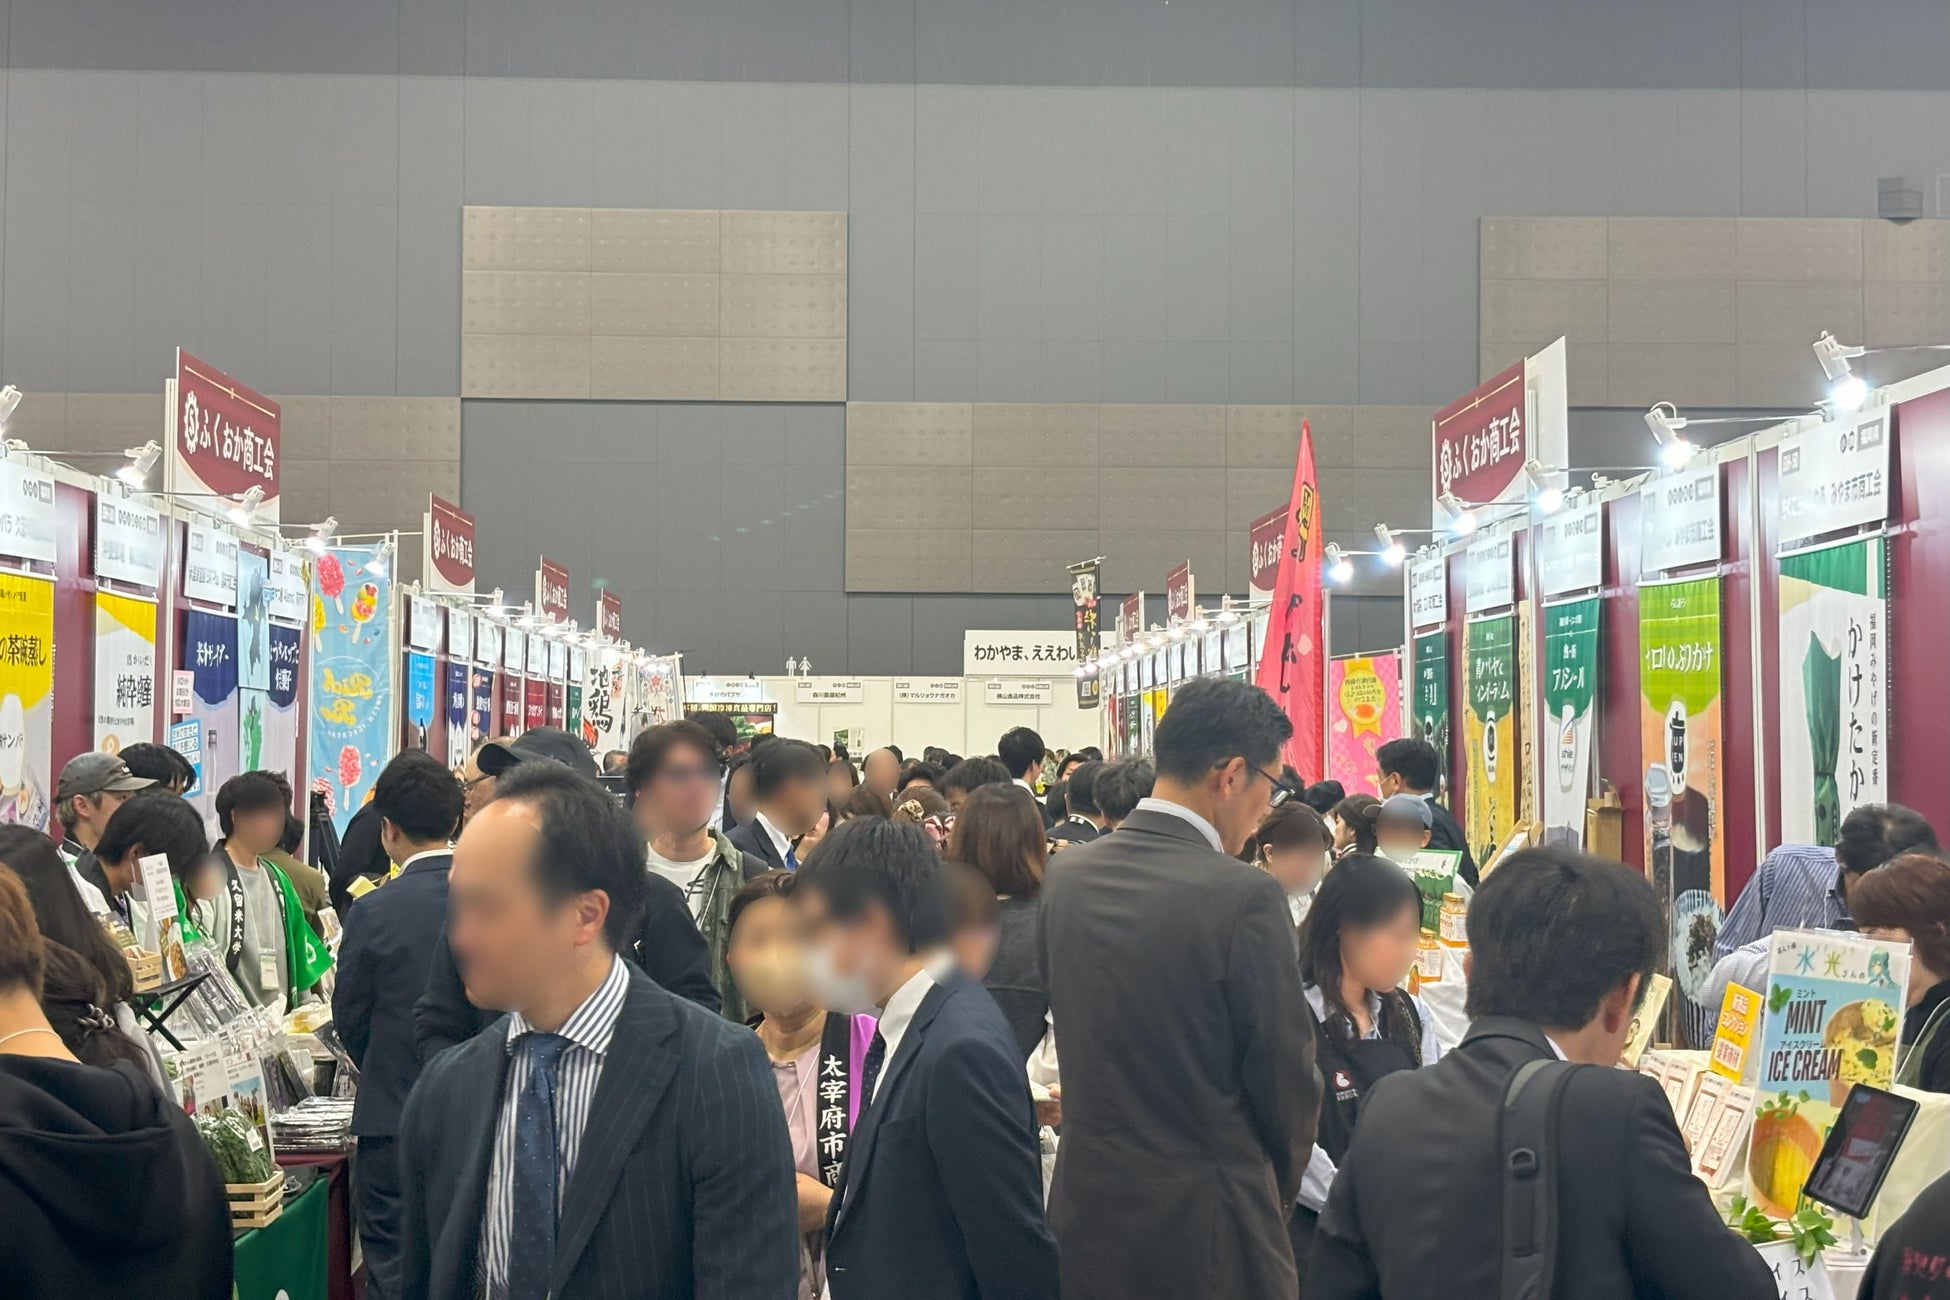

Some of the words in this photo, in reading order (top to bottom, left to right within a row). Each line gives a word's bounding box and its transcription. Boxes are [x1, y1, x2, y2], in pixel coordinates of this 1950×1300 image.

[199, 409, 276, 482] ふくおか商工会
[1452, 406, 1521, 480] ふくおか商工会
[441, 529, 473, 569] ふくおか商工会
[588, 665, 614, 734] 地鶏
[230, 879, 244, 956] 久留米大学
[1796, 988, 1816, 999] ミント
[1784, 999, 1827, 1034] MINT
[1780, 1039, 1826, 1050] アイスクリーム
[1767, 1050, 1792, 1082] ICE
[1792, 1048, 1843, 1082] CREAM
